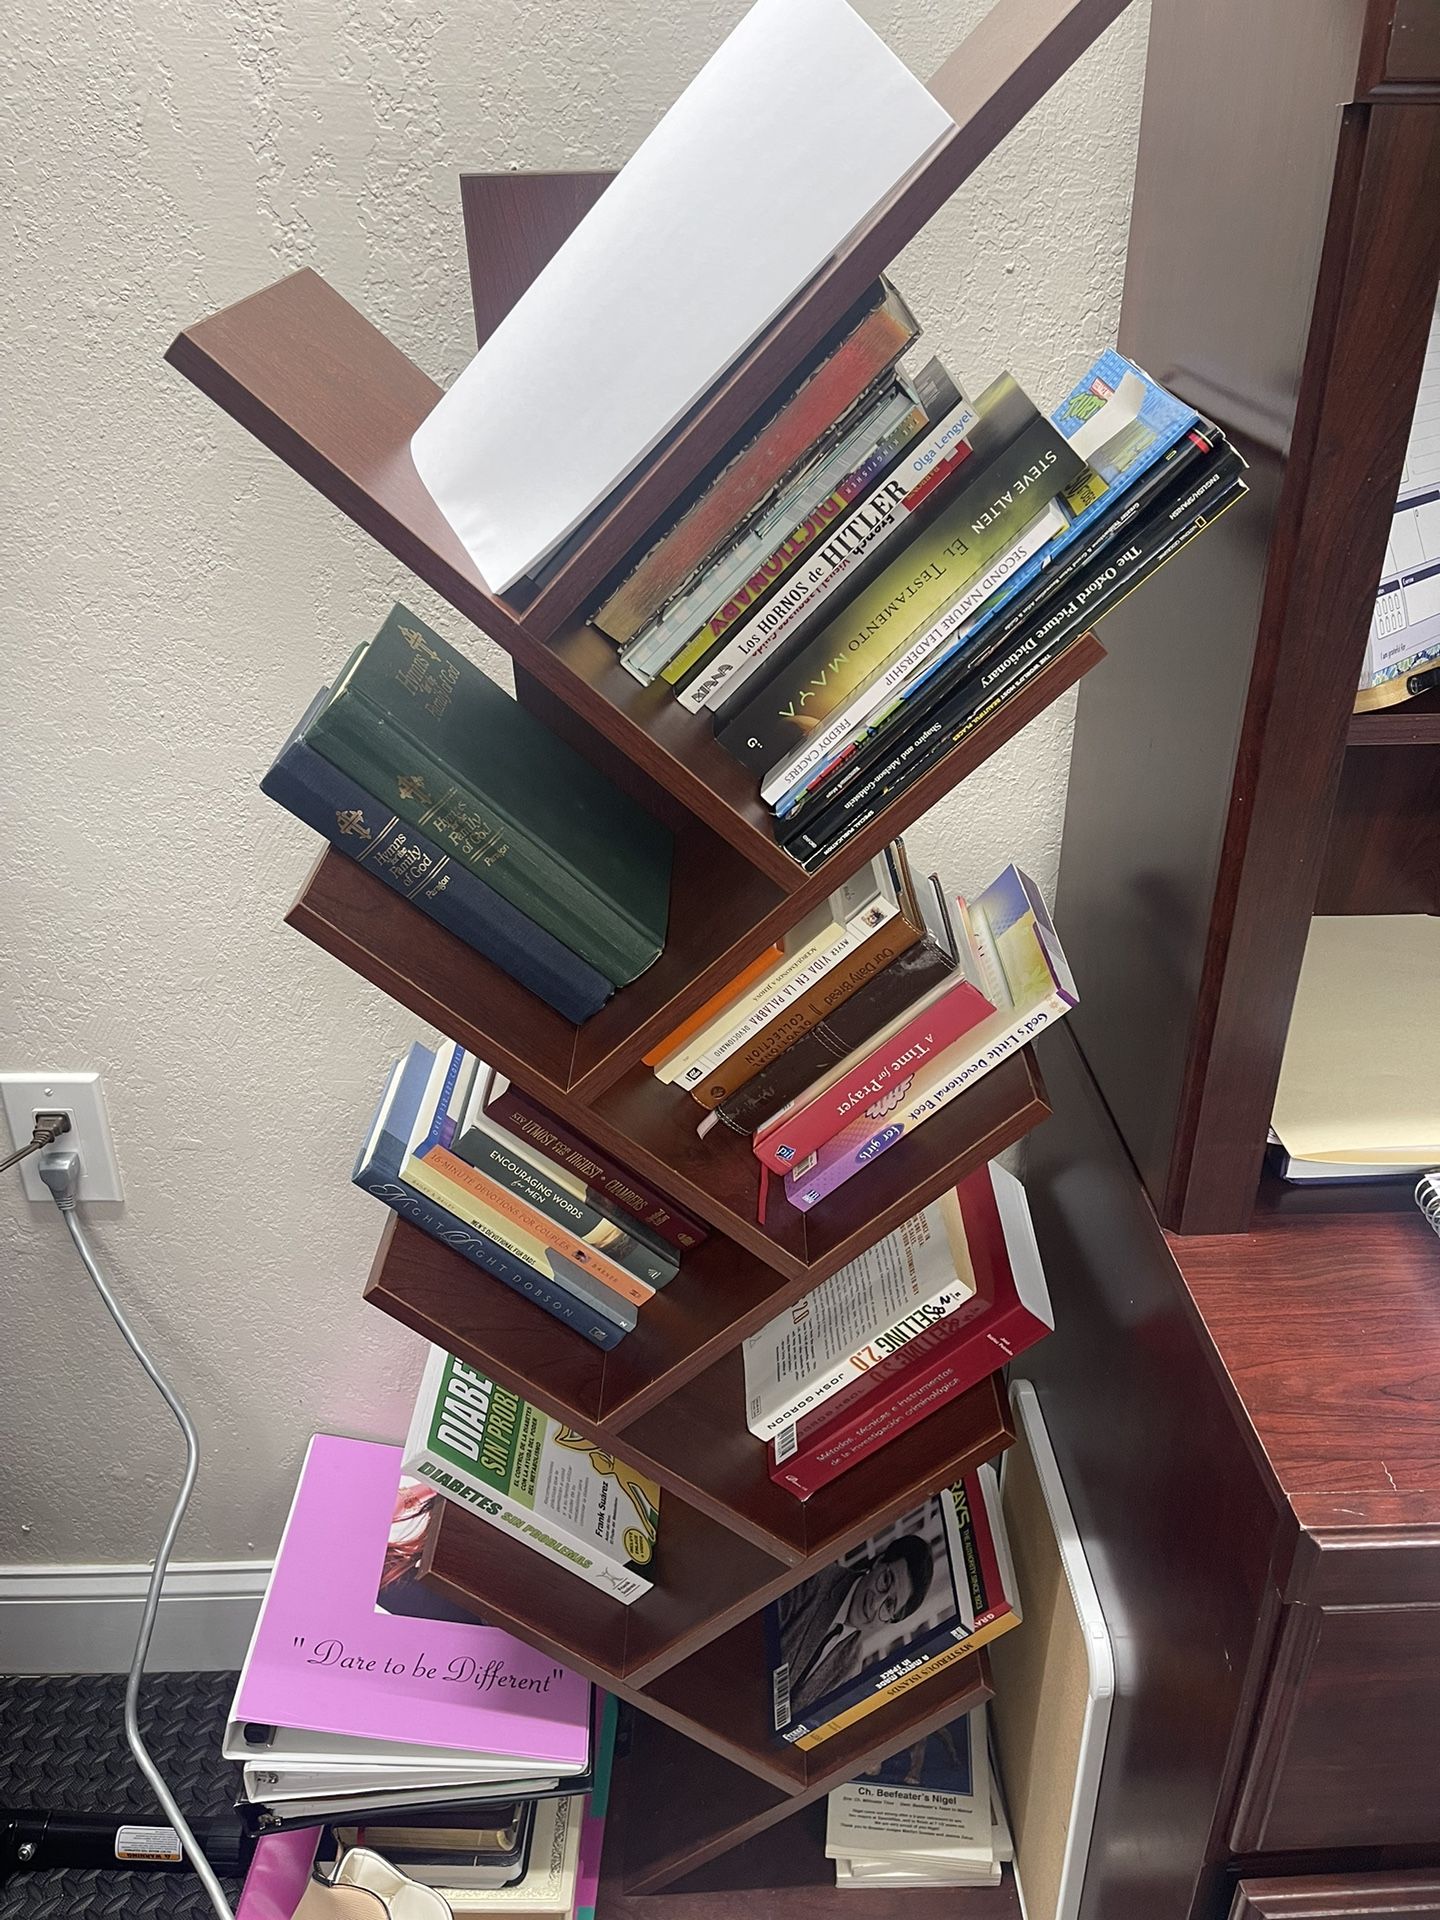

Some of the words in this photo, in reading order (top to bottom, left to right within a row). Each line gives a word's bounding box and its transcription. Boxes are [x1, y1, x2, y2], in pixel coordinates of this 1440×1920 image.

[911, 446, 938, 473] Olga
[933, 409, 974, 451] Lengyel
[842, 437, 900, 495] KINGFISHER
[1011, 449, 1057, 494] STEVE
[1119, 501, 1140, 521] Greater
[1167, 472, 1220, 520] ENGLISH/SPANISH
[968, 489, 1016, 535] ALTEN
[850, 513, 895, 559] French
[703, 495, 841, 637] DICTIONARY
[737, 631, 762, 655] Los
[755, 580, 809, 635] HORNOS
[805, 563, 825, 583] de
[818, 477, 909, 570] HITLER
[979, 545, 1027, 591] SECOND
[1070, 550, 1088, 567] Grand
[1113, 543, 1142, 570] The
[1074, 564, 1118, 605] Oxford
[939, 587, 984, 631] NATURE
[1033, 600, 1078, 642] Picture
[881, 627, 942, 686] LEADERSHIP
[978, 636, 1038, 691] Dictionary
[1039, 652, 1051, 664] THE
[393, 652, 430, 698] Hymns
[438, 659, 462, 685] God
[1013, 661, 1041, 686] WORLD'S
[998, 683, 1016, 700] MOST
[970, 697, 1001, 724] BEAUTIFUL
[816, 717, 851, 752] FREDDY
[911, 720, 942, 749] Shapiro
[951, 722, 973, 742] PLACES
[782, 747, 820, 784] CACERES
[899, 744, 916, 761] and
[842, 756, 903, 811] Adelson-Goldstein
[432, 799, 468, 834] Hymns
[447, 811, 484, 846] Family
[852, 809, 874, 829] SPECIAL
[373, 832, 408, 866] Hymns
[458, 838, 474, 854] of
[468, 821, 493, 846] God
[821, 826, 855, 855] PUBLICATION
[388, 843, 424, 879] Family
[399, 872, 415, 887] of
[408, 852, 433, 879] God
[829, 938, 849, 957] MEYER
[871, 945, 894, 966] Our
[793, 972, 809, 987] EN
[807, 953, 831, 976] VIDA
[847, 959, 876, 986] Daily
[781, 983, 796, 997] LA
[822, 980, 852, 1007] Bread
[747, 993, 784, 1027] PALABRA
[1015, 1010, 1049, 1039] God's
[713, 1023, 751, 1058] DEVOCIONARIO
[742, 1011, 804, 1065] COLLECTION
[923, 1033, 934, 1044] A
[985, 1033, 1019, 1062] Little
[890, 1039, 930, 1074] Time
[874, 1065, 891, 1082] for
[932, 1056, 988, 1104] Devotional
[831, 1075, 883, 1117] Prayer
[906, 1098, 934, 1123] Book
[519, 1117, 558, 1149] UTMOST
[880, 1123, 900, 1143] for
[564, 1148, 603, 1181] HIGHEST
[857, 1137, 882, 1162] girls
[489, 1149, 553, 1198] ENCOURAGING
[550, 1192, 584, 1220] WORDS
[510, 1176, 526, 1192] for
[523, 1185, 547, 1204] MEN
[603, 1176, 648, 1214] CHAMBERS
[473, 1181, 521, 1217] DEVOTIONS
[517, 1211, 537, 1228] FOR
[533, 1222, 571, 1251] COUPLES
[367, 1174, 446, 1232] NIGHT
[511, 1273, 573, 1318] DOBSON
[469, 1219, 487, 1233] MEN'S
[484, 1228, 515, 1252] DEVOTIONAL
[512, 1247, 524, 1258] FOR
[520, 1253, 536, 1266] DADS
[901, 1232, 909, 1246] YOUR
[904, 1246, 915, 1276] CUSTOMERS
[873, 1300, 940, 1357] SELLING
[847, 1341, 882, 1375] 2.0
[814, 1371, 845, 1396] JOSH
[437, 1357, 494, 1462] DIABE
[521, 1406, 532, 1433] DIABETES
[766, 1394, 814, 1430] GORDON
[816, 1434, 857, 1462] Métodos,
[855, 1409, 891, 1437] técnicas
[897, 1366, 954, 1407] instrumentos
[829, 1456, 841, 1466] de
[840, 1449, 850, 1458] la
[850, 1413, 905, 1453] investigación
[903, 1375, 961, 1417] criminológica
[520, 1433, 527, 1441] LA
[529, 1417, 537, 1436] PODER
[480, 1438, 511, 1477] SIN
[519, 1441, 526, 1450] DE
[523, 1448, 532, 1469] AYUDA
[513, 1450, 524, 1478] CONTROL
[522, 1469, 529, 1477] LA
[528, 1441, 541, 1483] METABOLISMO
[417, 1459, 503, 1518] DIABETES
[513, 1479, 520, 1487] EL
[520, 1477, 528, 1491] CON
[598, 1480, 609, 1510] Suárez
[595, 1511, 604, 1537] Frank
[962, 1528, 970, 1542] THE
[499, 1509, 525, 1530] SIN
[521, 1522, 593, 1570] PROBLEMAS
[962, 1541, 977, 1575] AUTHORITY
[969, 1573, 981, 1594] SINCE
[384, 1657, 405, 1675] to
[412, 1653, 437, 1679] be
[878, 1663, 902, 1680] SPACE
[896, 1657, 923, 1677] MATCH
[899, 1657, 911, 1667] IN
[920, 1653, 929, 1661] A
[920, 1640, 973, 1677] MYSTERIOUS
[874, 1672, 897, 1690] MADE
[885, 1671, 922, 1697] ISLANDS
[858, 1787, 874, 1796] Ch.
[876, 1789, 930, 1802] Beefeater's
[932, 1794, 957, 1805] Nigel
